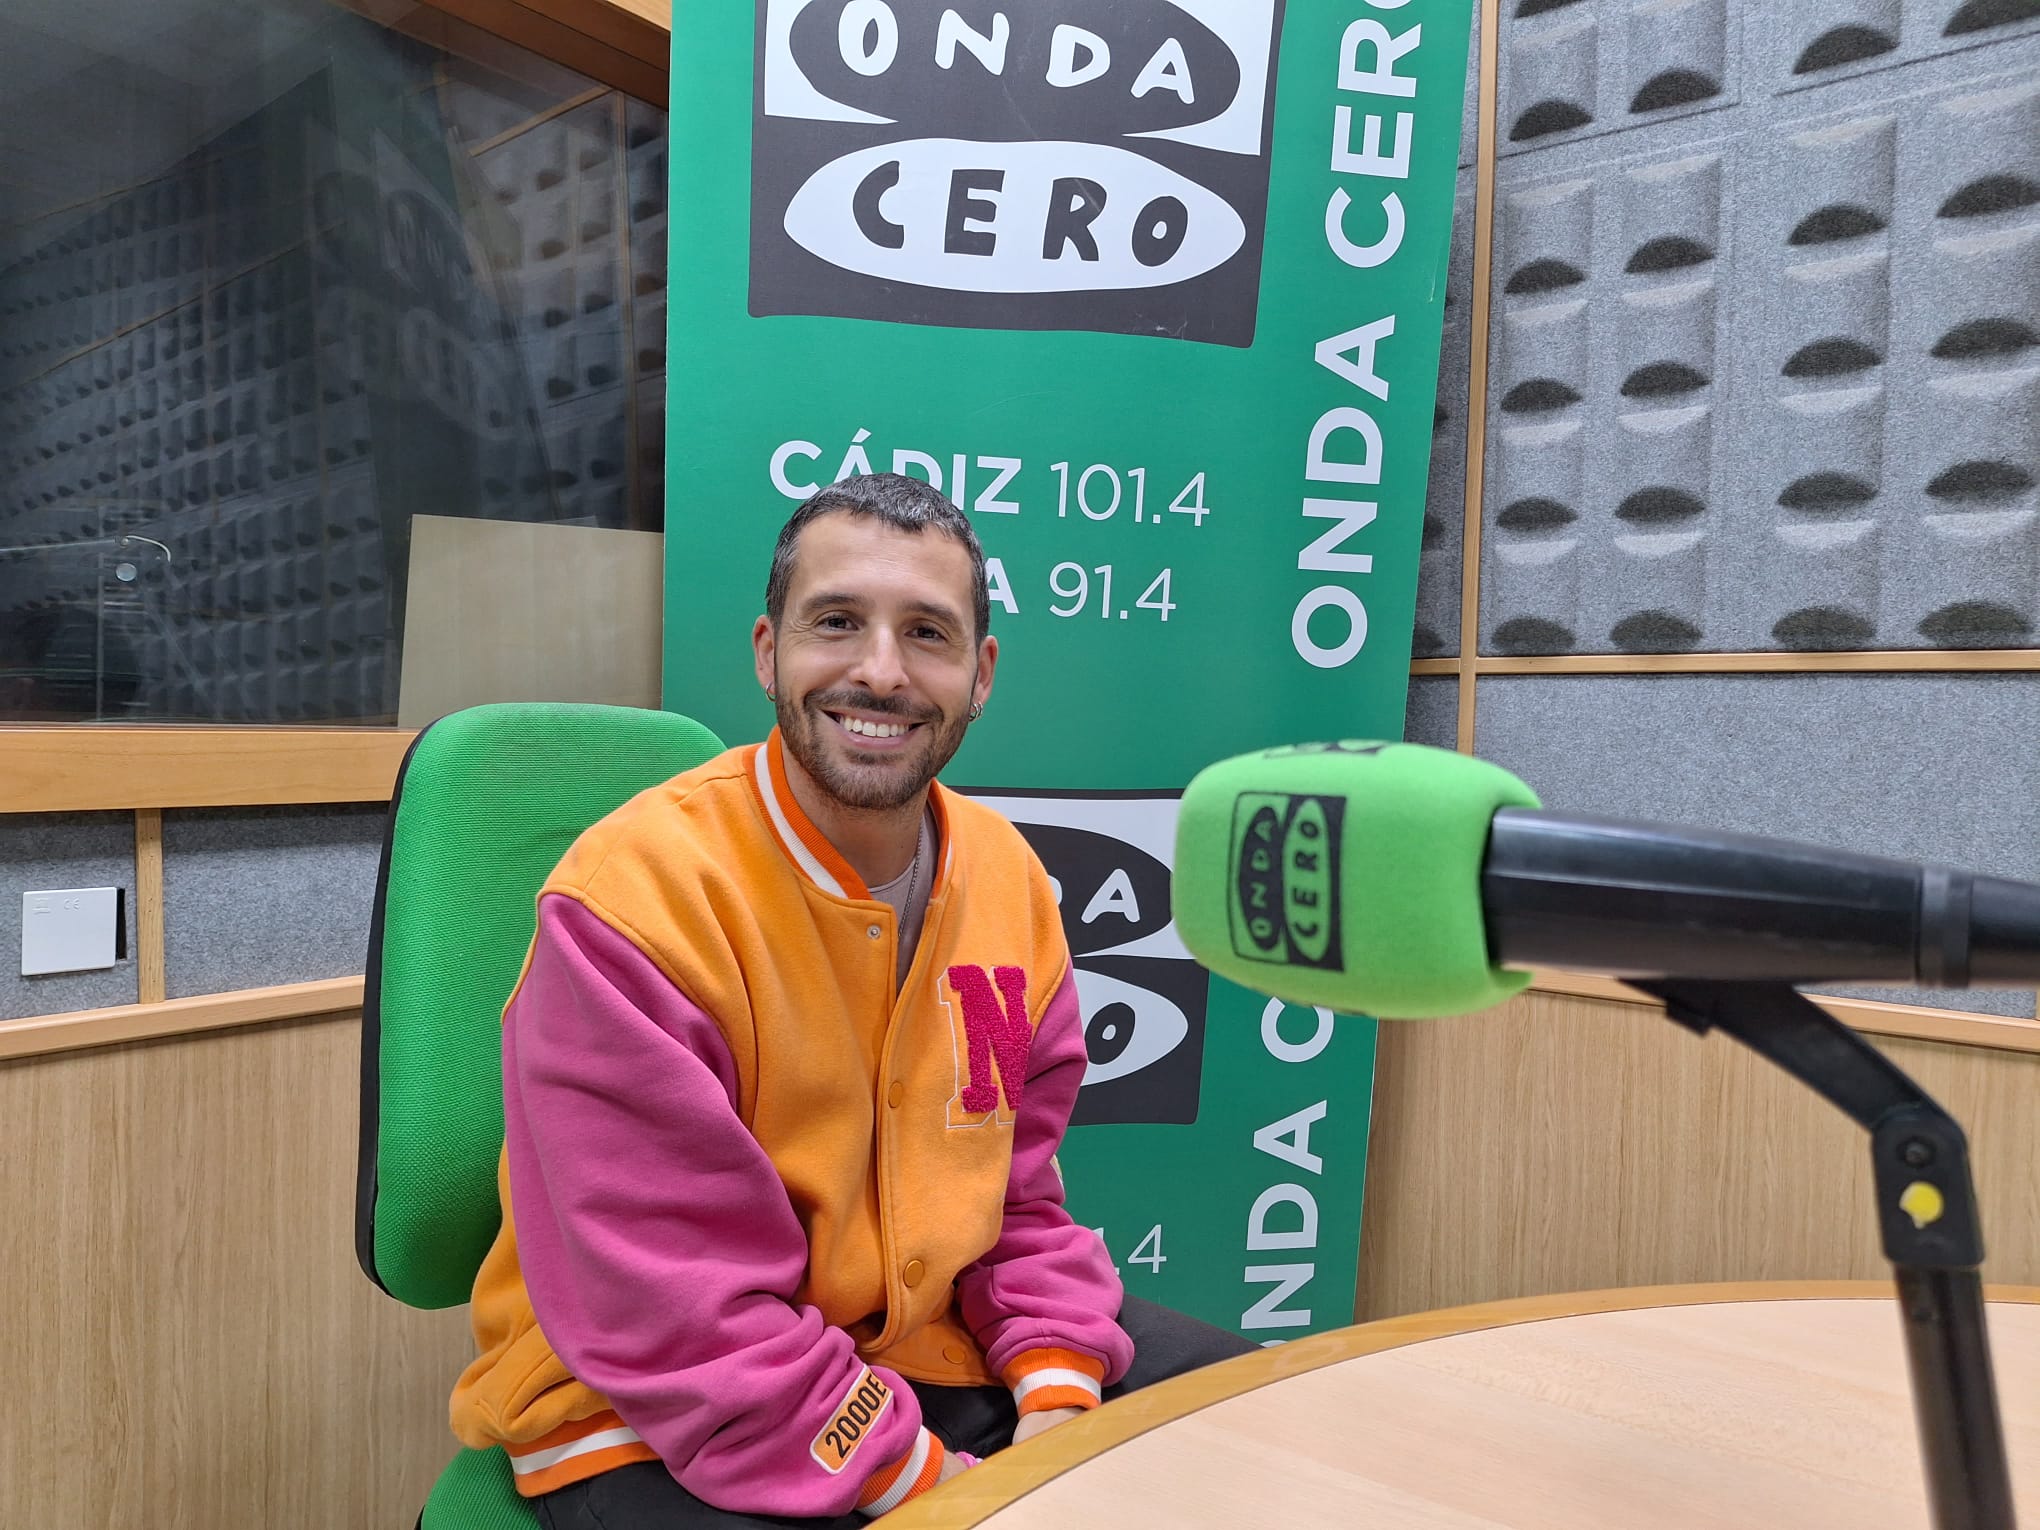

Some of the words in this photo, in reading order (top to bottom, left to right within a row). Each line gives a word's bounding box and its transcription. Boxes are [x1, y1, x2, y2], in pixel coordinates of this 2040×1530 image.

[838, 0, 1195, 104] ONDA
[1325, 0, 1422, 268] CER
[853, 160, 1188, 267] CERO
[1050, 461, 1210, 526] 101.4
[1292, 314, 1396, 668] ONDA
[1049, 562, 1176, 621] 91.4
[1250, 820, 1273, 939] ONDA
[1293, 820, 1319, 938] CERO
[943, 964, 1033, 1118] N
[1242, 1100, 1327, 1348] NDA
